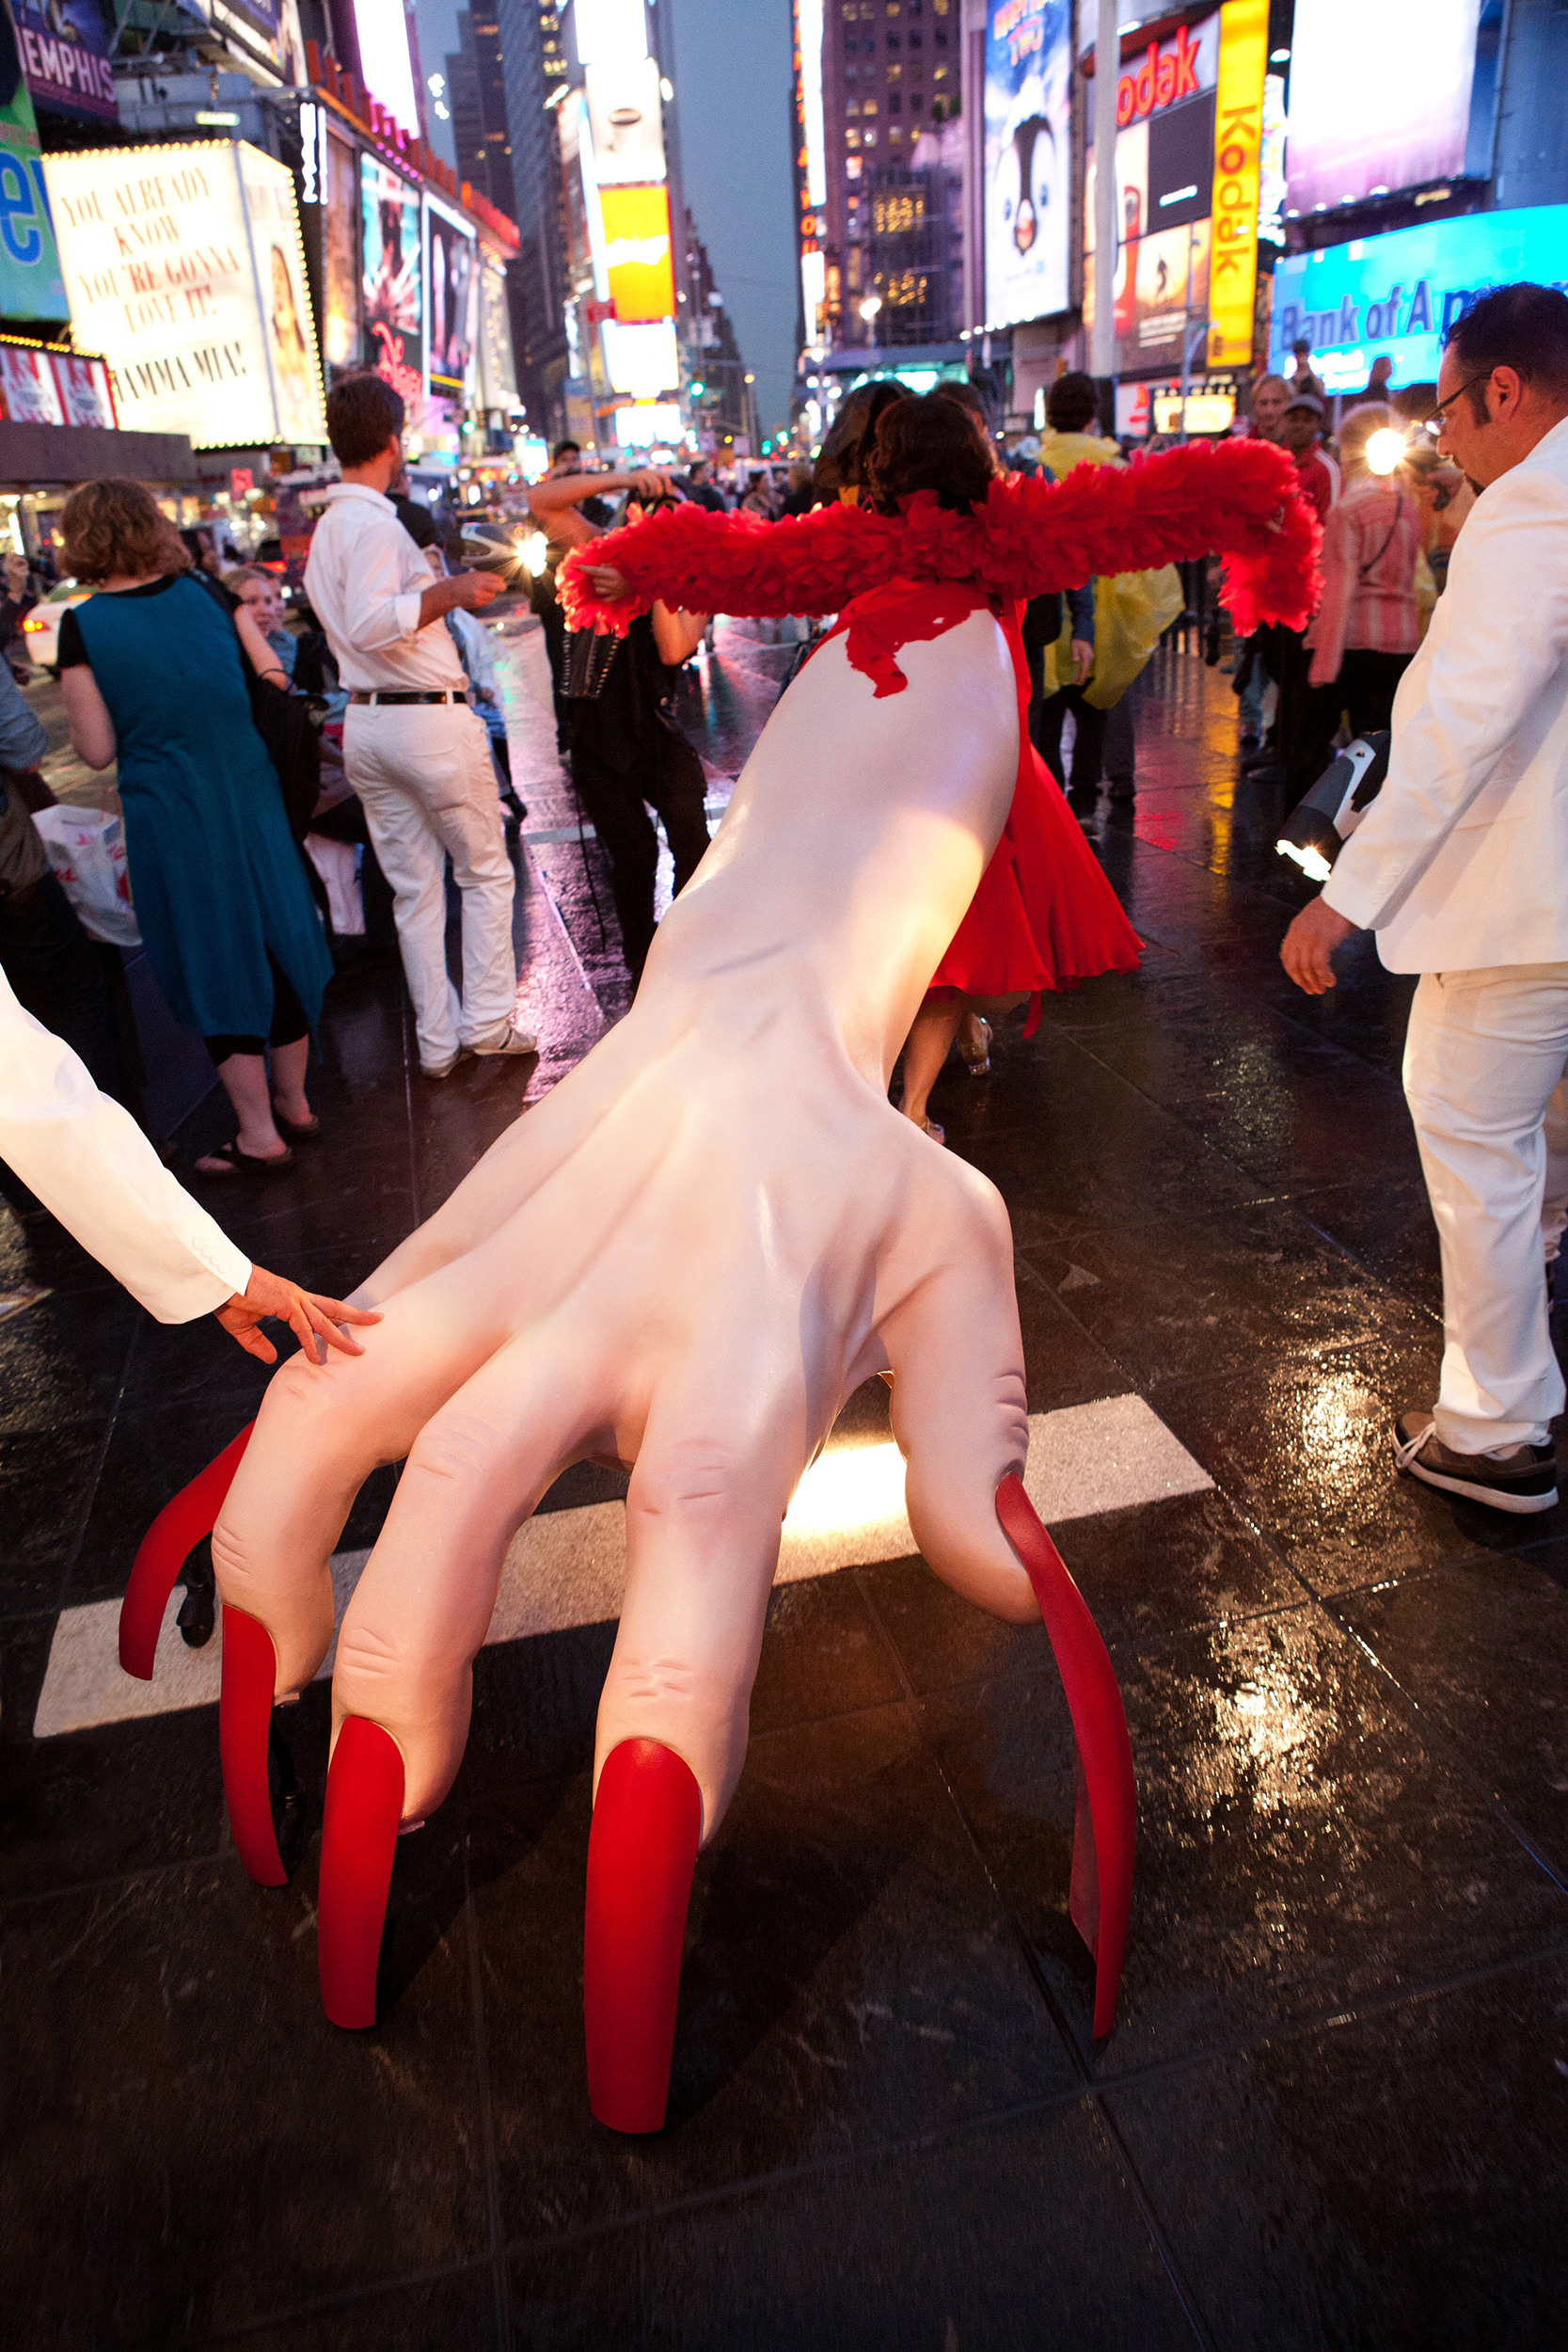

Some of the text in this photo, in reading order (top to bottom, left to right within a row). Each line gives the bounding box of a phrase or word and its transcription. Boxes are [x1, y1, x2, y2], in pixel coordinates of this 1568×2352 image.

[1116, 25, 1199, 125] odak
[61, 167, 210, 227] YOU ALREADY
[1217, 105, 1257, 275] Kodak
[114, 215, 180, 257] KNOW
[165, 245, 240, 284] GONNA
[124, 293, 178, 332] LOVE
[1281, 294, 1361, 351] Bank
[1366, 285, 1404, 340] of
[194, 342, 245, 382] MIA!
